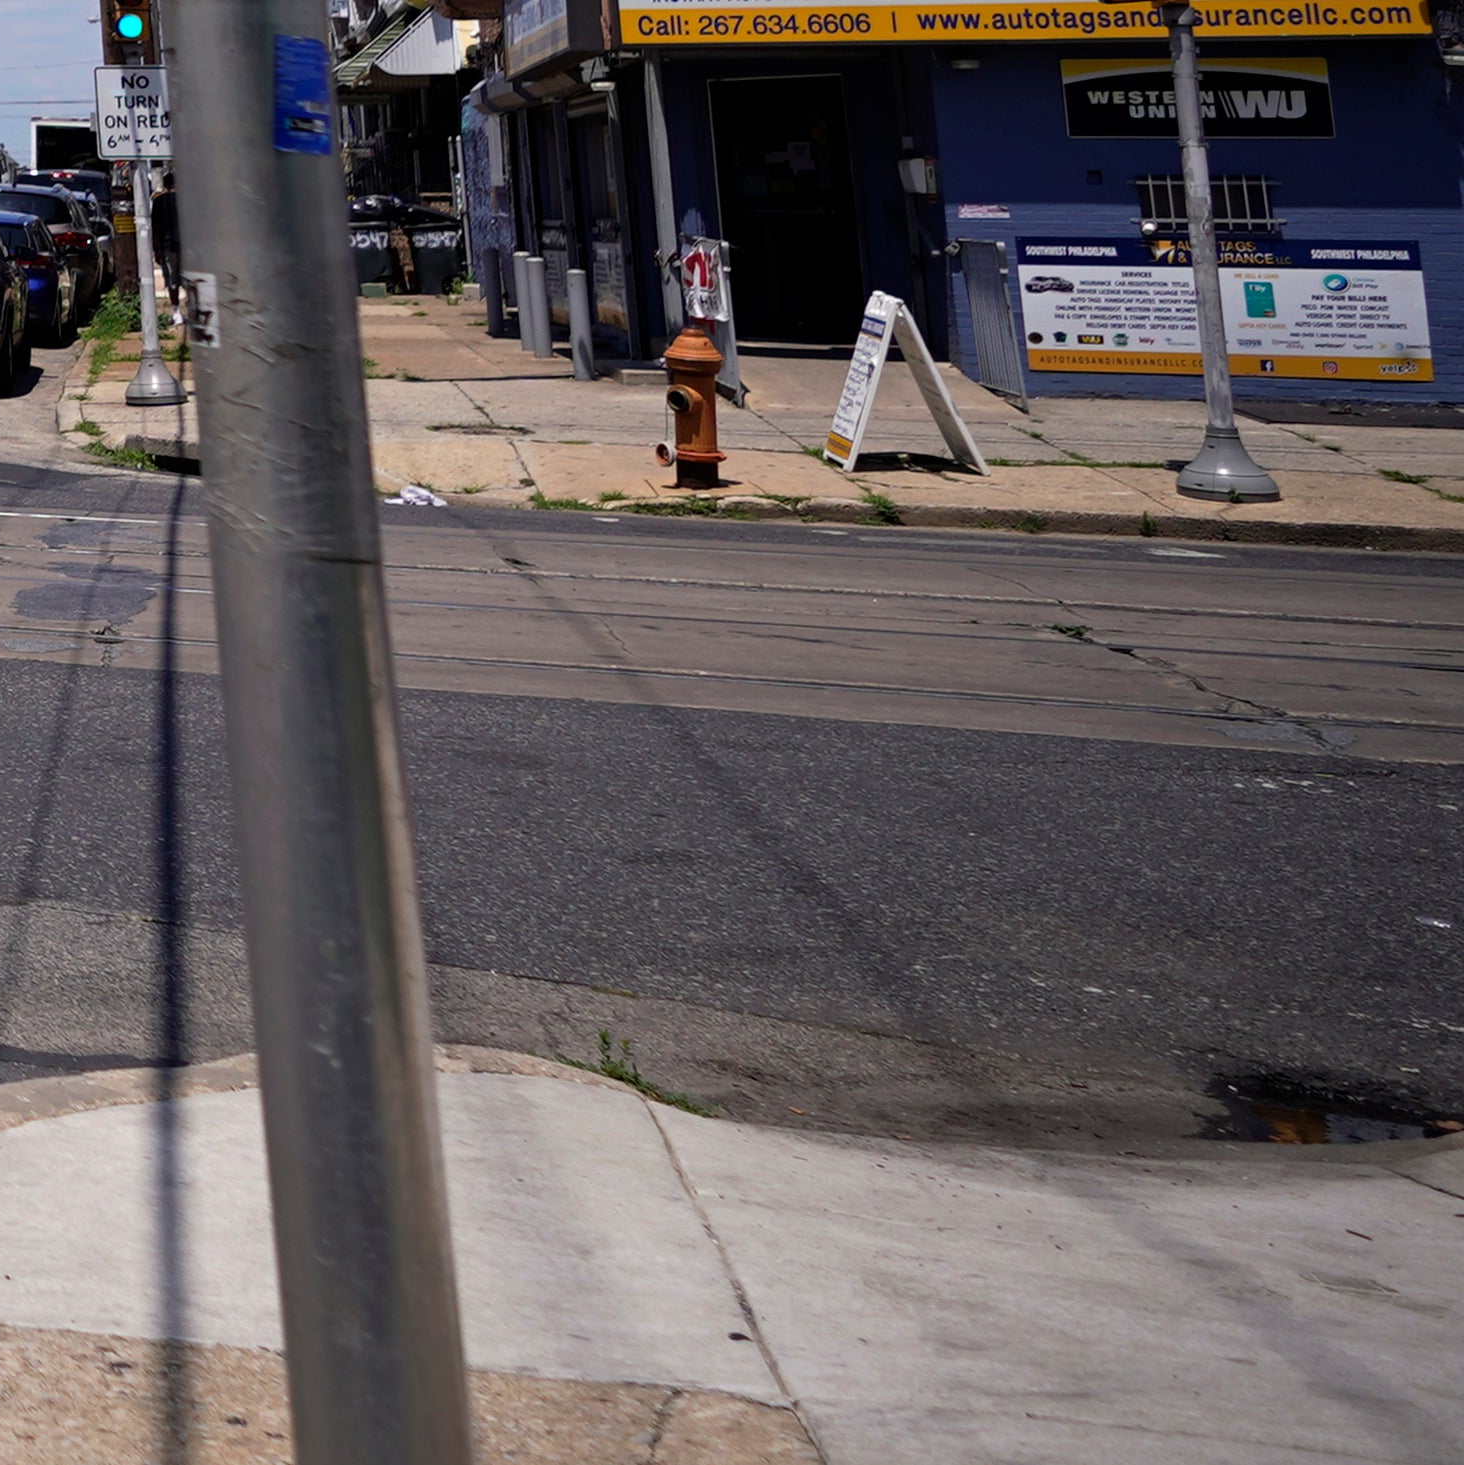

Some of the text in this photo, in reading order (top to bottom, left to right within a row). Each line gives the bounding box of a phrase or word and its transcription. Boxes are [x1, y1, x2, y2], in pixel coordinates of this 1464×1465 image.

[637, 3, 1412, 36] Call: 267.634.6606 www.autotagsandsurancellc.com
[121, 75, 149, 89] NO
[115, 95, 159, 109] TURN
[1087, 90, 1308, 119] WESTEN WU
[1129, 105, 1216, 118] UNIN
[104, 115, 171, 129] ON RED
[1025, 246, 1118, 257] SOUTHWEST PHILADELPHIA
[1219, 241, 1256, 252] TAGS
[1311, 249, 1410, 260] SOUTHWEST PHILADELPHIA
